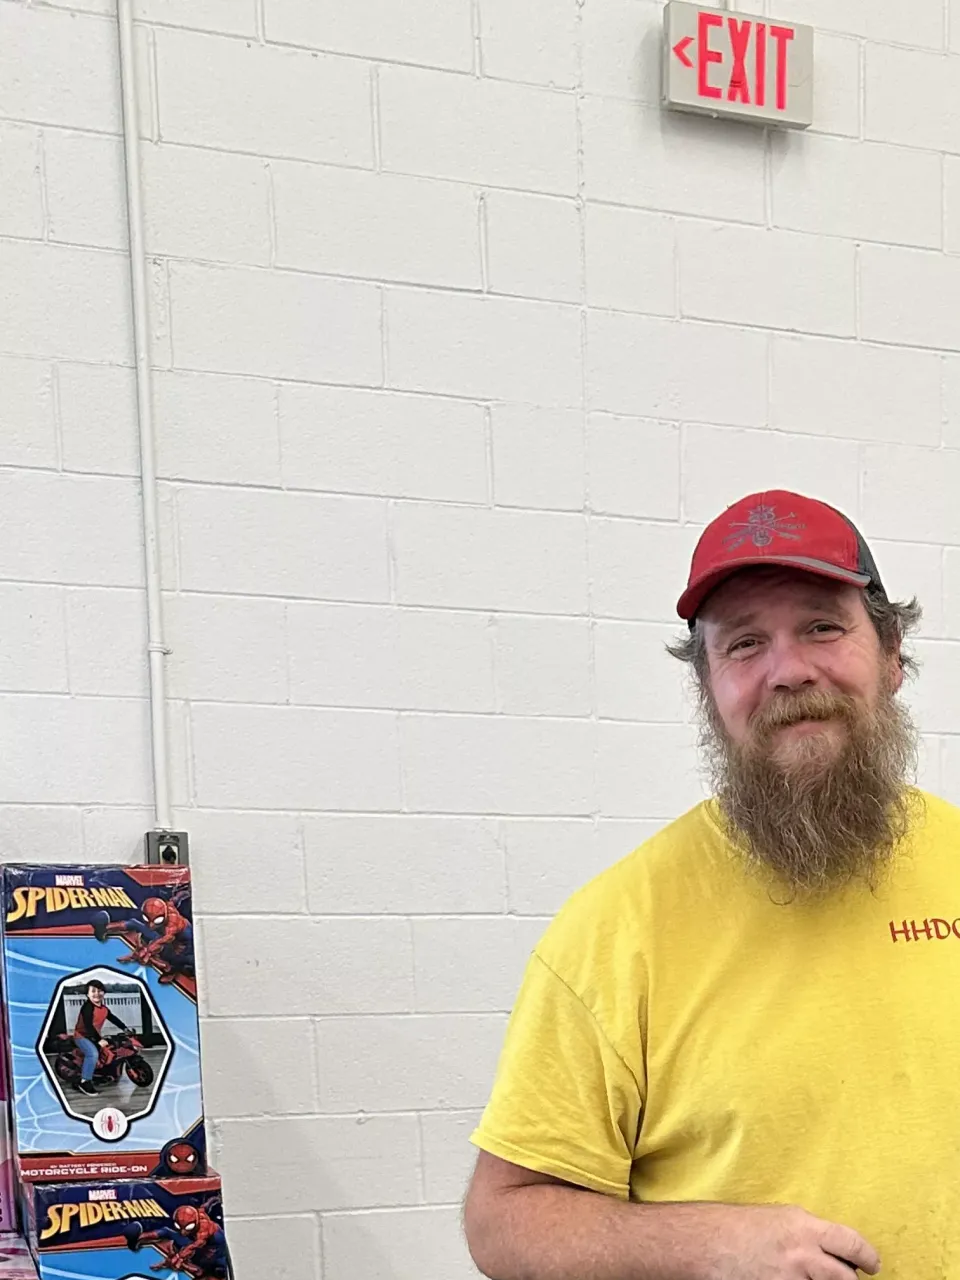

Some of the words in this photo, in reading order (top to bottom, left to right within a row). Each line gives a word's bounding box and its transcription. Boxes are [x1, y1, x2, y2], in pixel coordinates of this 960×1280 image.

[697, 11, 795, 111] EXIT
[55, 875, 84, 887] MARVEL
[7, 886, 138, 923] SPIDER-MAN
[21, 1166, 98, 1178] MOTORCYCLE
[101, 1164, 148, 1175] RIDE-ON
[88, 1189, 117, 1200] MARVEL
[40, 1198, 170, 1240] SPIDER-MAN
